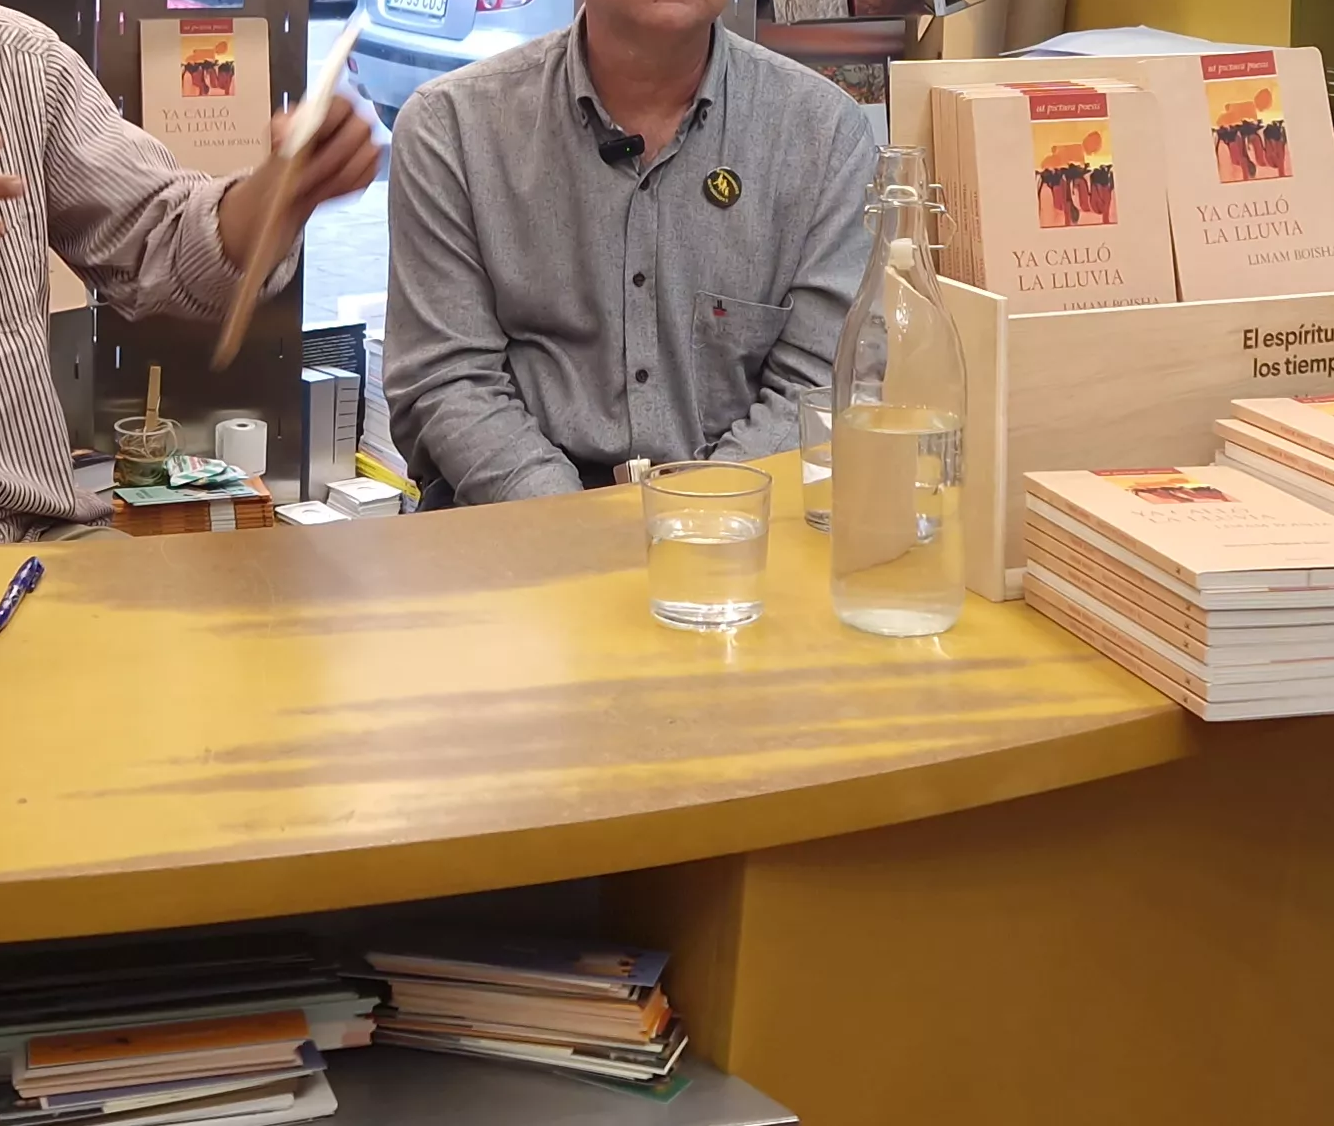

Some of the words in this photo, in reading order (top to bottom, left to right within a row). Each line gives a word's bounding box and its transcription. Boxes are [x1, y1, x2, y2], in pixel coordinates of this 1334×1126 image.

[162, 107, 179, 120] YA
[164, 121, 184, 133] LA
[1197, 206, 1221, 223] YA
[1227, 195, 1289, 218] CALLÓ
[1203, 228, 1229, 245] LA
[1236, 220, 1303, 242] LLUVIA
[1012, 250, 1039, 269] YA
[1045, 242, 1111, 267] CALLÓ
[1247, 249, 1290, 266] LIMAM
[1018, 275, 1044, 292] LA
[1052, 269, 1124, 290] LLUVIA
[1243, 329, 1260, 349] El
[1252, 357, 1280, 379] los
